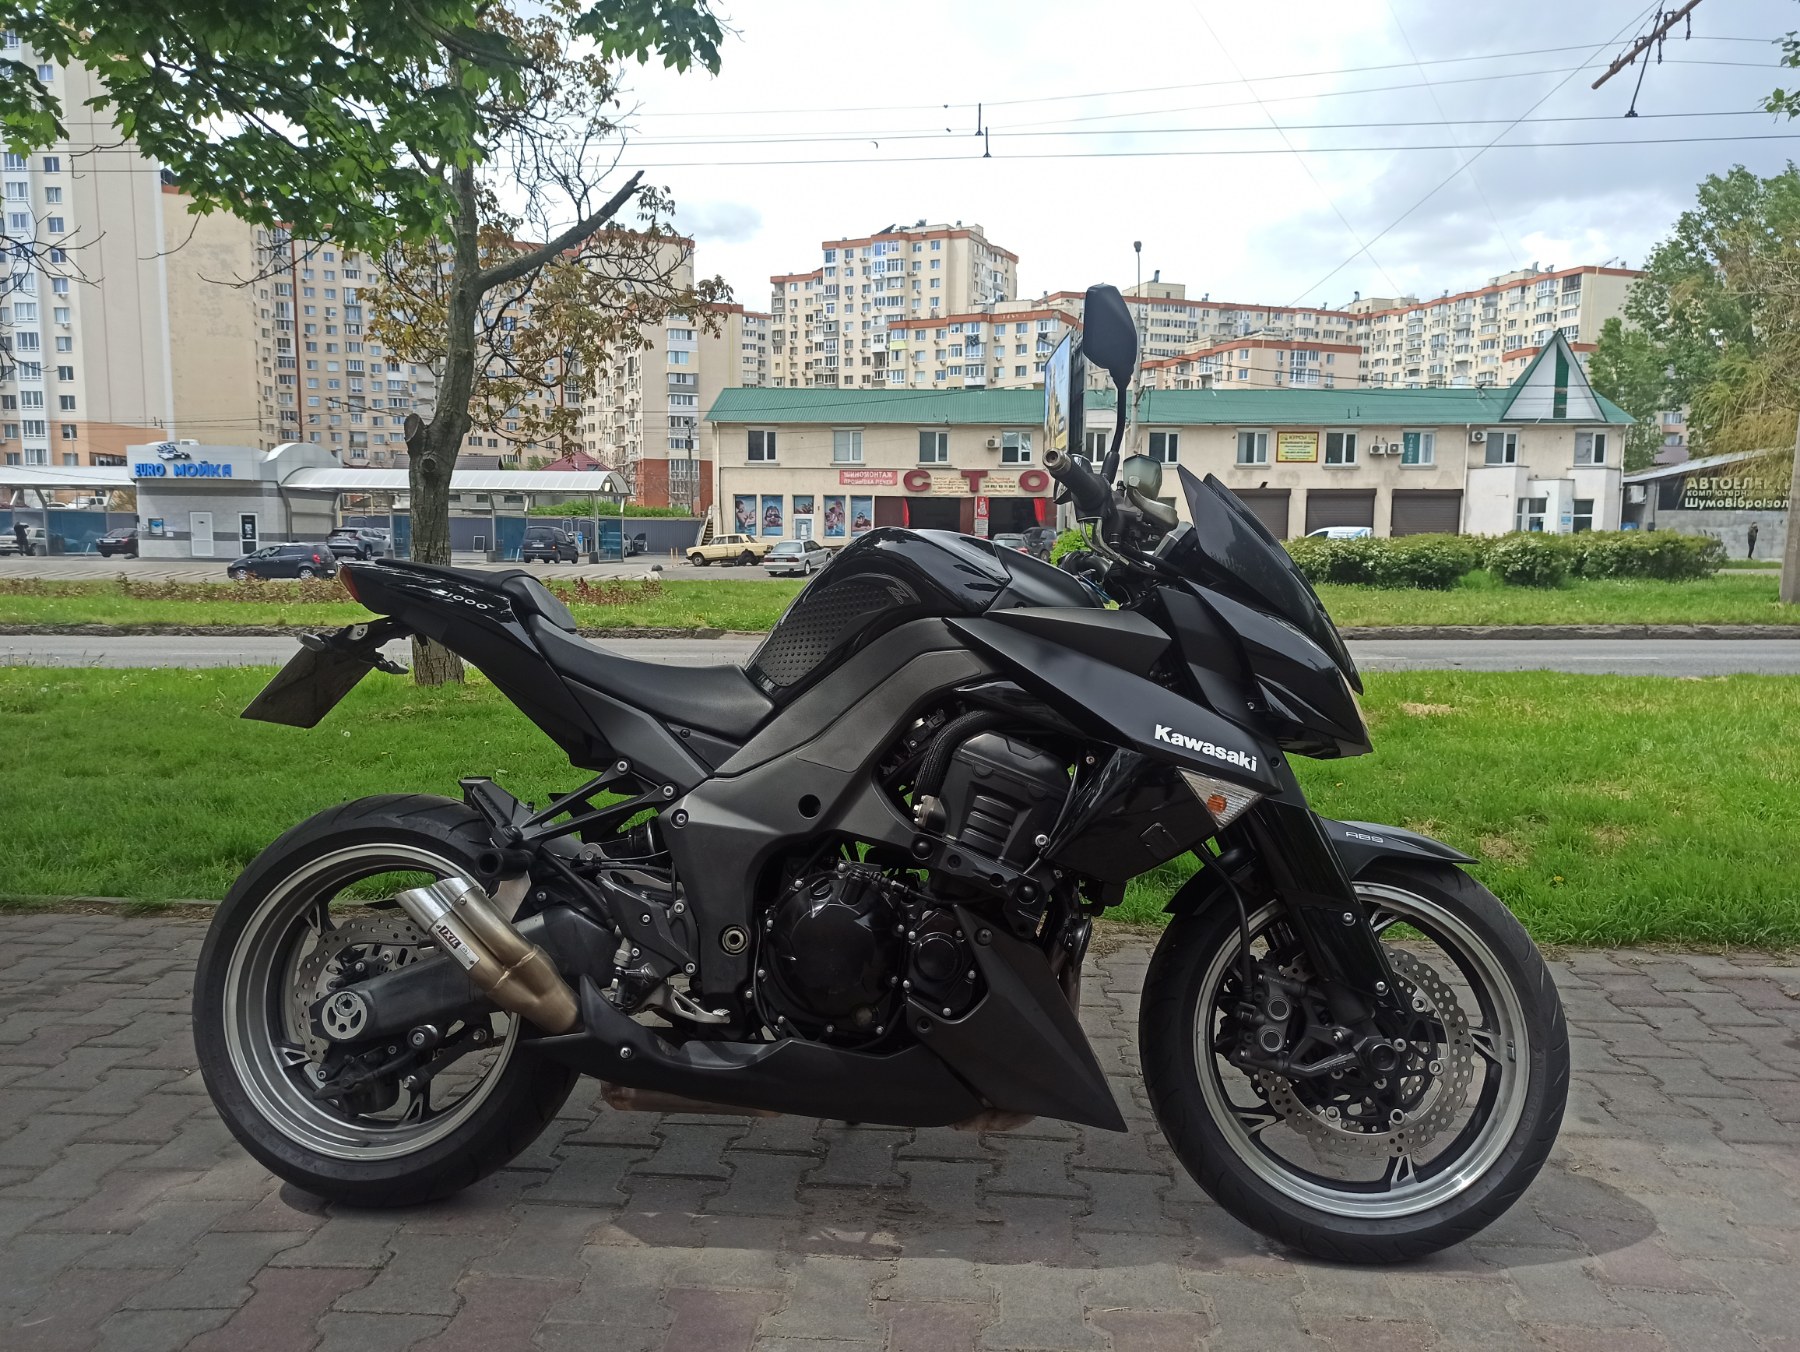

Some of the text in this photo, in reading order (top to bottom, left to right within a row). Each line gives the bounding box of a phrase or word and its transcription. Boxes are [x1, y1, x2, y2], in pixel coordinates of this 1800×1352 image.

[134, 460, 232, 478] EURO МОЙКА
[1154, 723, 1257, 772] Kawasaki
[1345, 831, 1384, 843] ABS
[440, 927, 460, 947] IXIL
